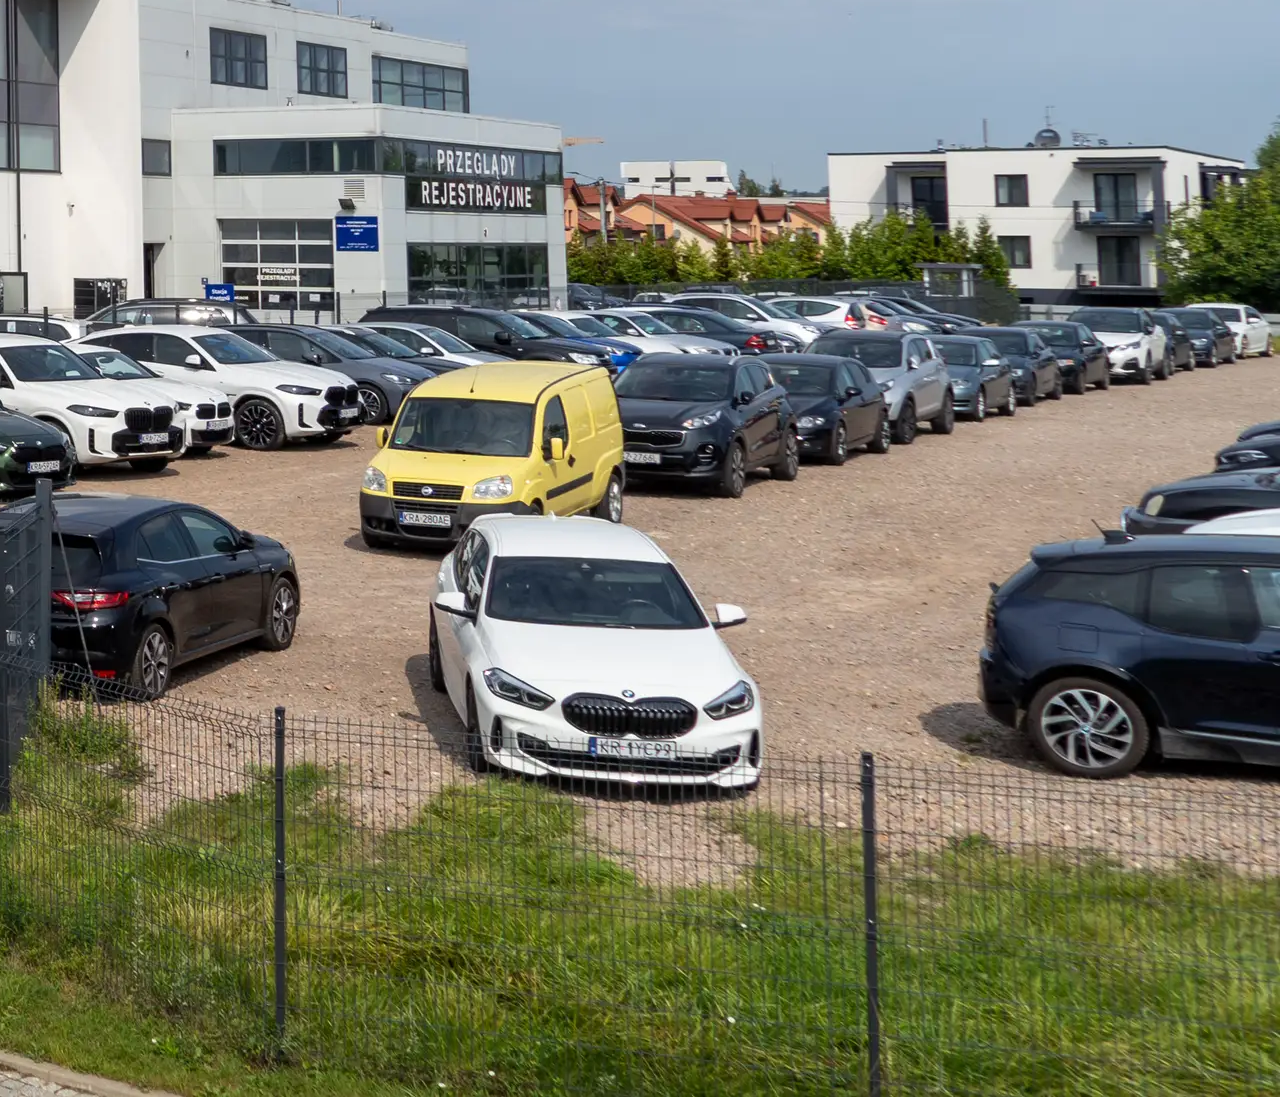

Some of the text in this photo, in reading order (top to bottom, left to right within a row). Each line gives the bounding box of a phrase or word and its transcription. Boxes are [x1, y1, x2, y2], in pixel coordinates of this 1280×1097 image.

[437, 149, 516, 180] PRZEGLĄDY
[421, 181, 532, 208] REJESTRACYJNE
[212, 288, 228, 296] Stacja
[404, 513, 449, 525] KRA 280AE
[599, 740, 672, 757] KR 1YC99
